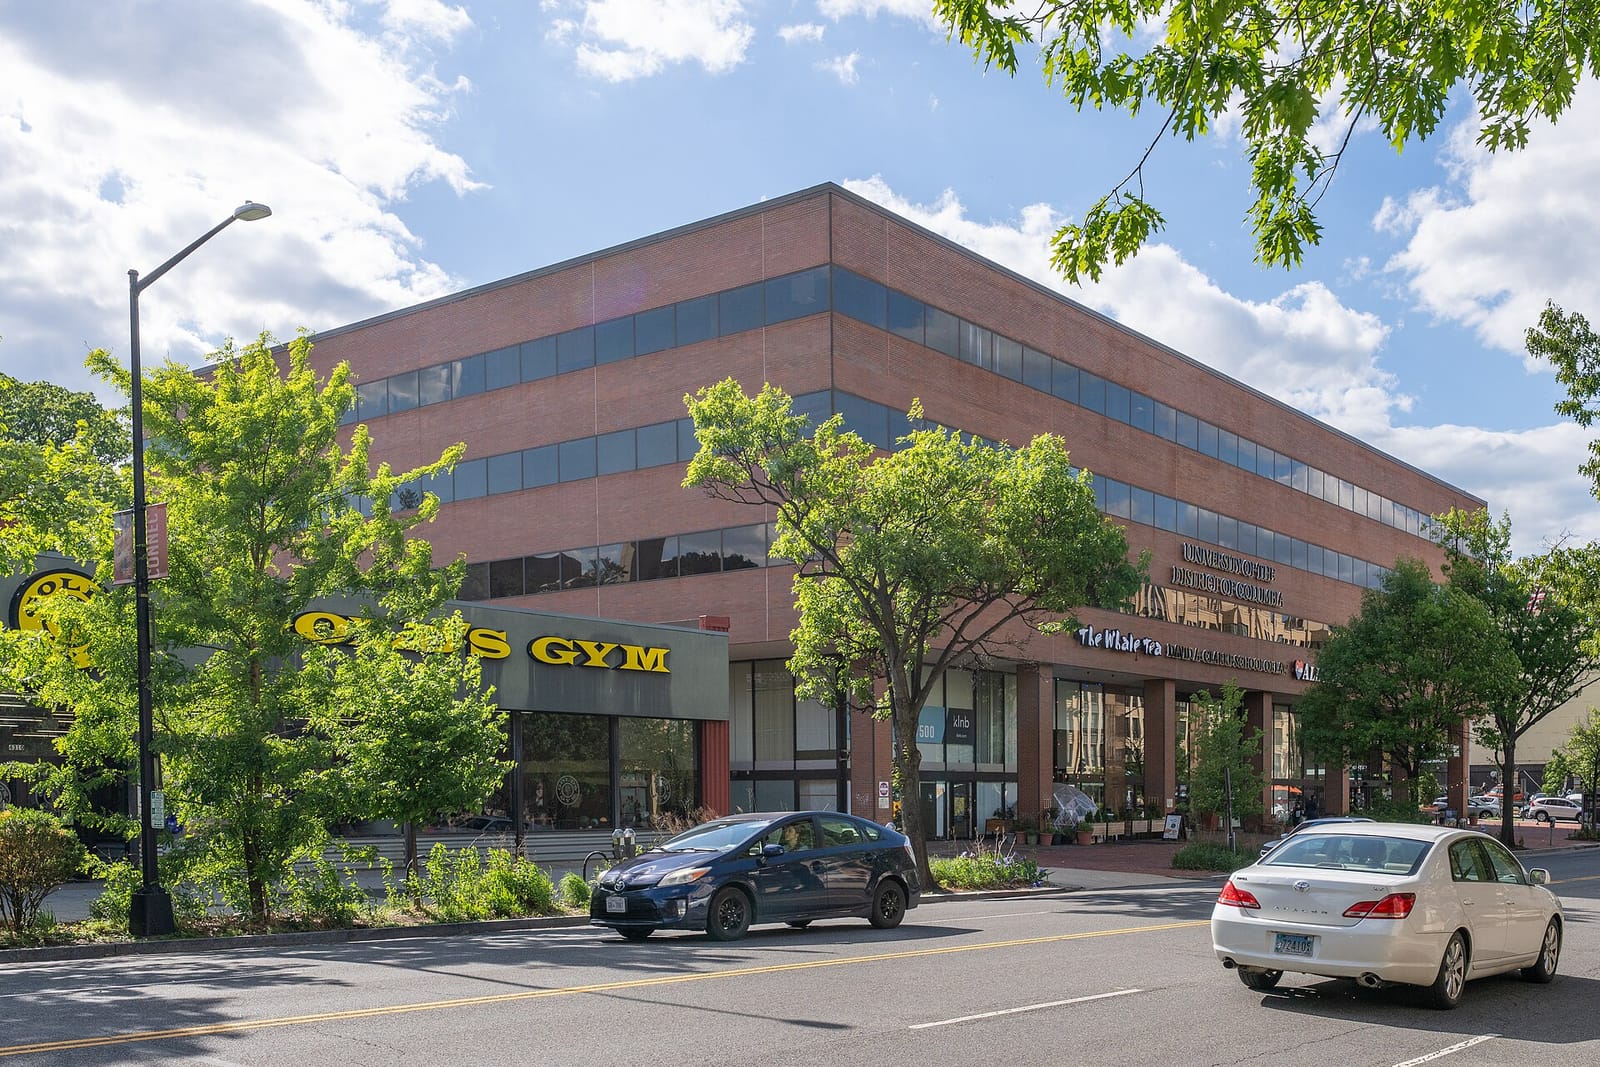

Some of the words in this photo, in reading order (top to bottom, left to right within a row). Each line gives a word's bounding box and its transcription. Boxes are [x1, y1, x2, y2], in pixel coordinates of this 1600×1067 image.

[1183, 542, 1242, 575] UNIVERSITY
[1242, 559, 1257, 577] OF
[1171, 565, 1219, 594] DISTRICT
[1220, 578, 1236, 597] OF
[1235, 581, 1285, 608] COLUMBIA
[530, 635, 671, 674] GYM
[1077, 625, 1103, 647] The
[1104, 628, 1141, 654] Whale
[1142, 637, 1163, 656] Tea
[953, 714, 970, 729] klnb
